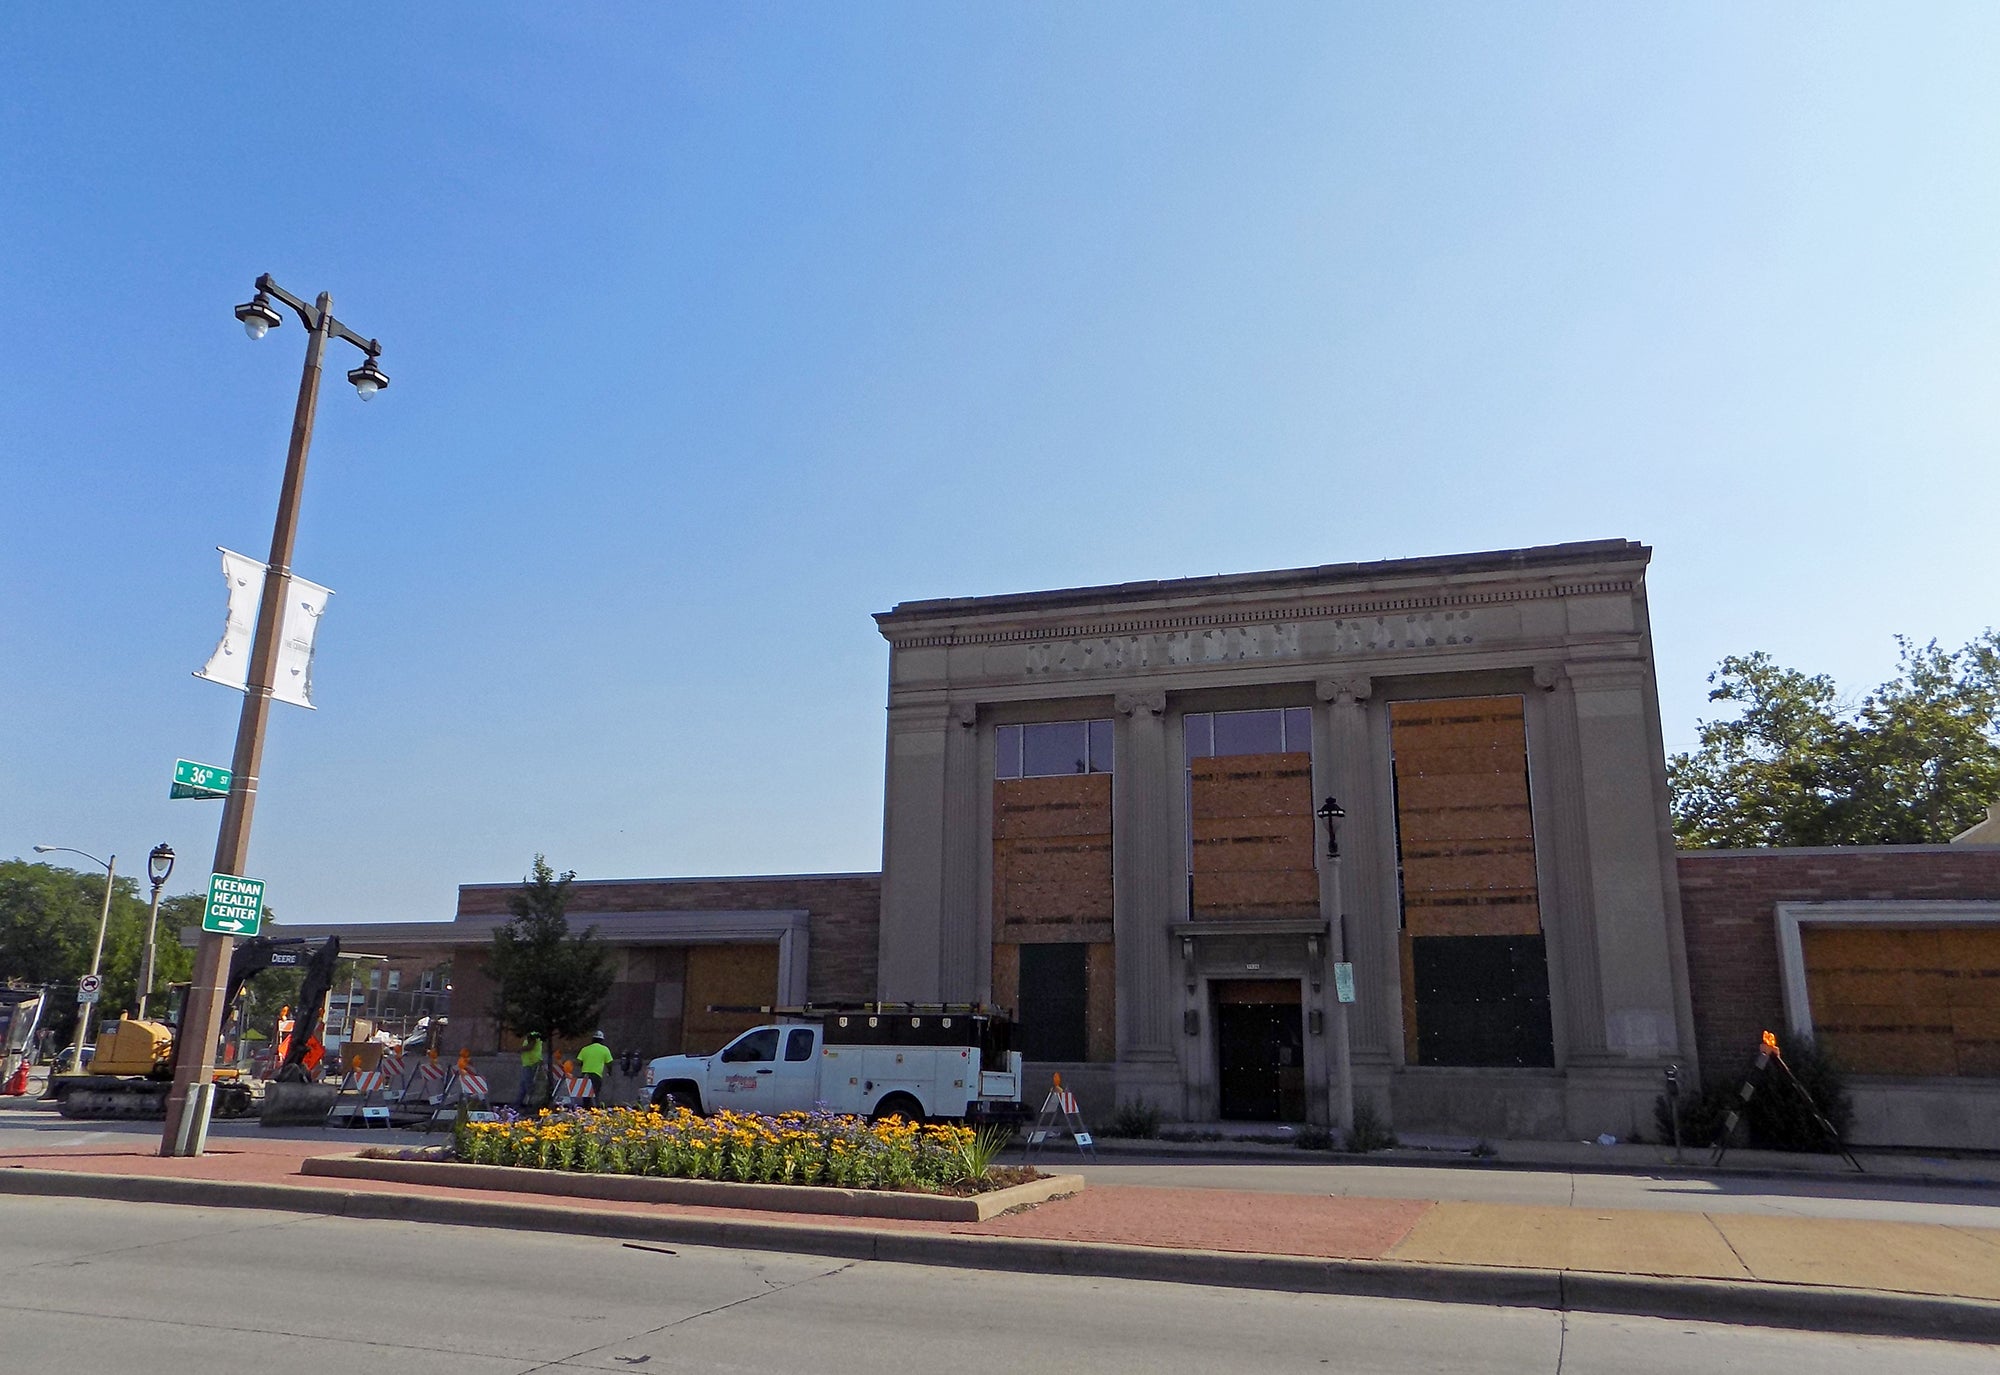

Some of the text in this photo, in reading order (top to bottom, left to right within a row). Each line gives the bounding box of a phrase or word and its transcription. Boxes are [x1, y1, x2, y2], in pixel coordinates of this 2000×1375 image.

[178, 767, 184, 776] N
[220, 775, 229, 785] ST
[214, 878, 261, 895] KEENAN
[213, 891, 258, 908] HEALTH
[211, 904, 256, 920] CENTER
[271, 953, 296, 963] DEERE
